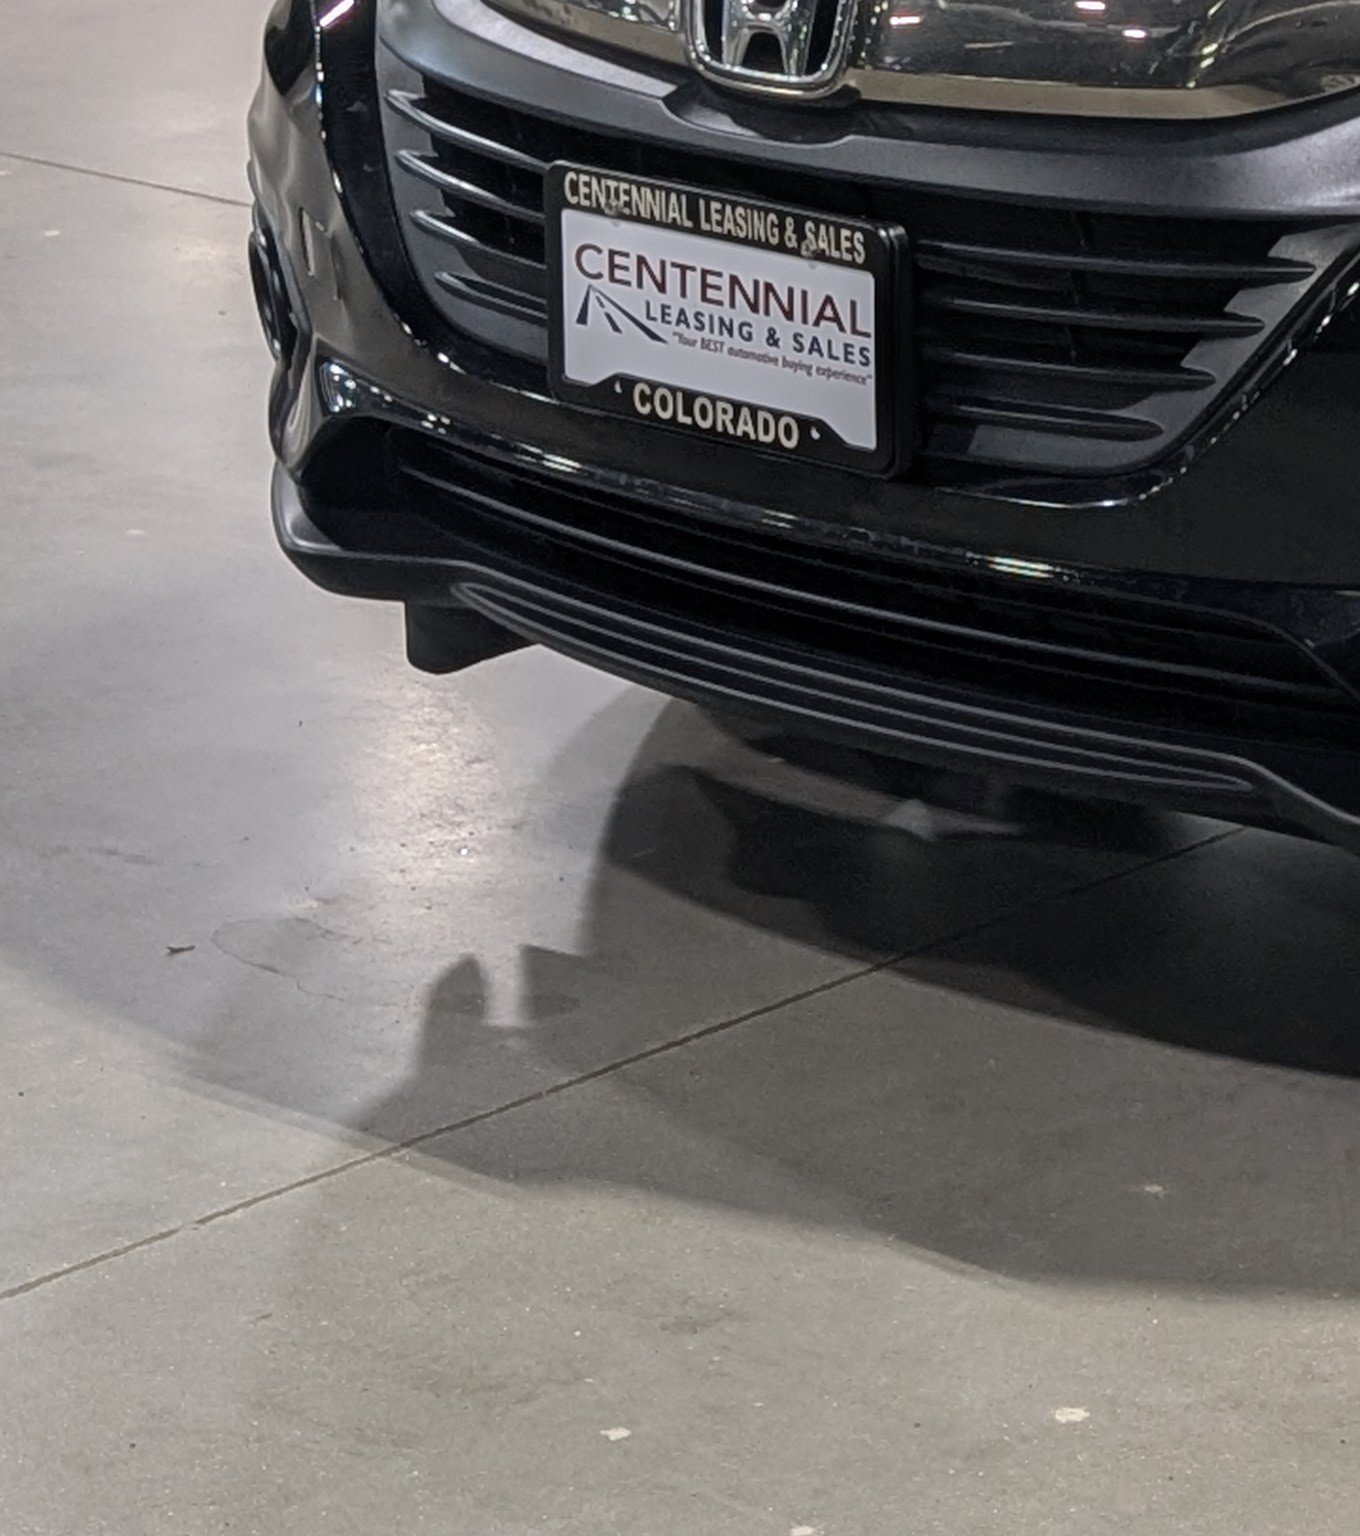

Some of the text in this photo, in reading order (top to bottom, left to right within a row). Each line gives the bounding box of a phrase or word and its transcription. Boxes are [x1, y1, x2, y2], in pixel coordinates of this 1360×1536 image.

[563, 170, 866, 264] CENTENNIAL LEASING & SALES
[574, 243, 872, 339] CENTENNIAL
[645, 300, 872, 368] LEASING & SALES
[701, 337, 726, 355] BEST
[633, 382, 800, 450] COLORADO
